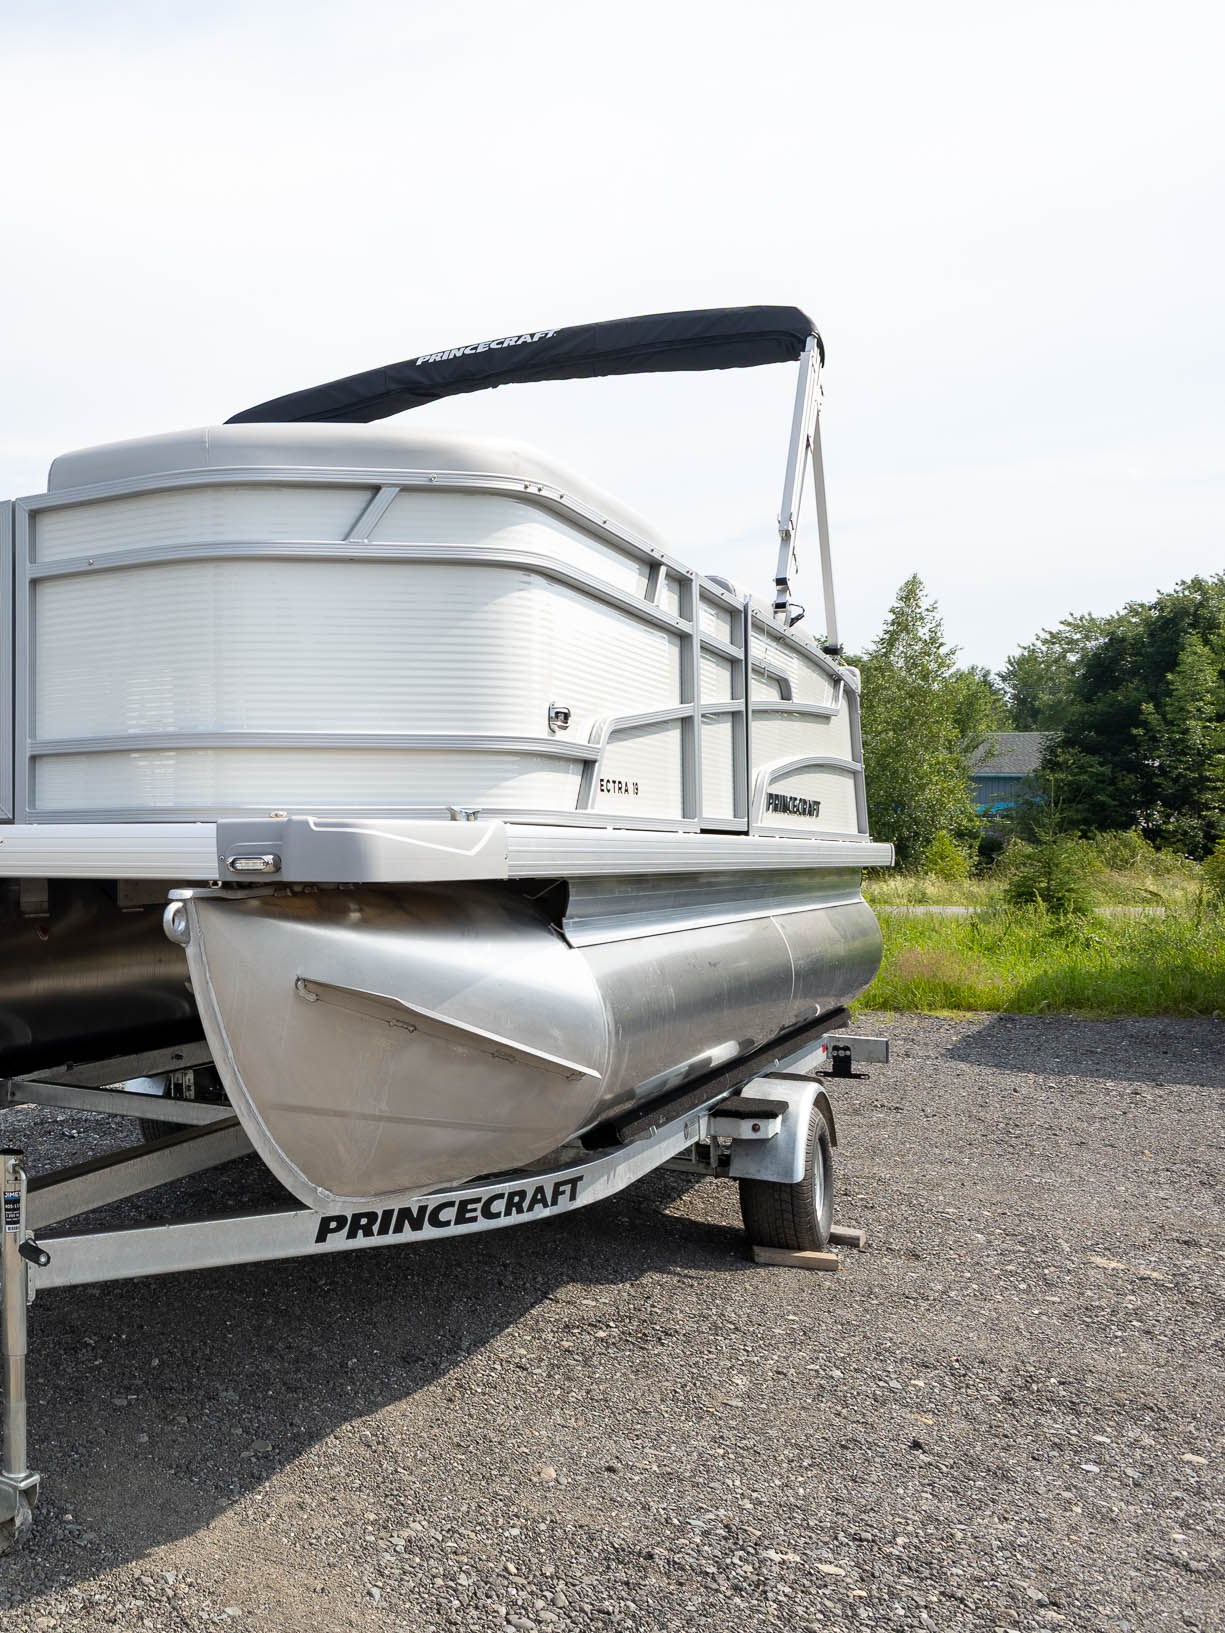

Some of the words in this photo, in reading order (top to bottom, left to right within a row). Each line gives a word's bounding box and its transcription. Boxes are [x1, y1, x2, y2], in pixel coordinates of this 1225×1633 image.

[415, 329, 558, 366] PRINCECRAFT
[599, 778, 630, 795] ECTRA
[632, 781, 640, 796] 19
[765, 792, 822, 818] PRINCECRAFT
[314, 1174, 585, 1244] PRINCECRAFT
